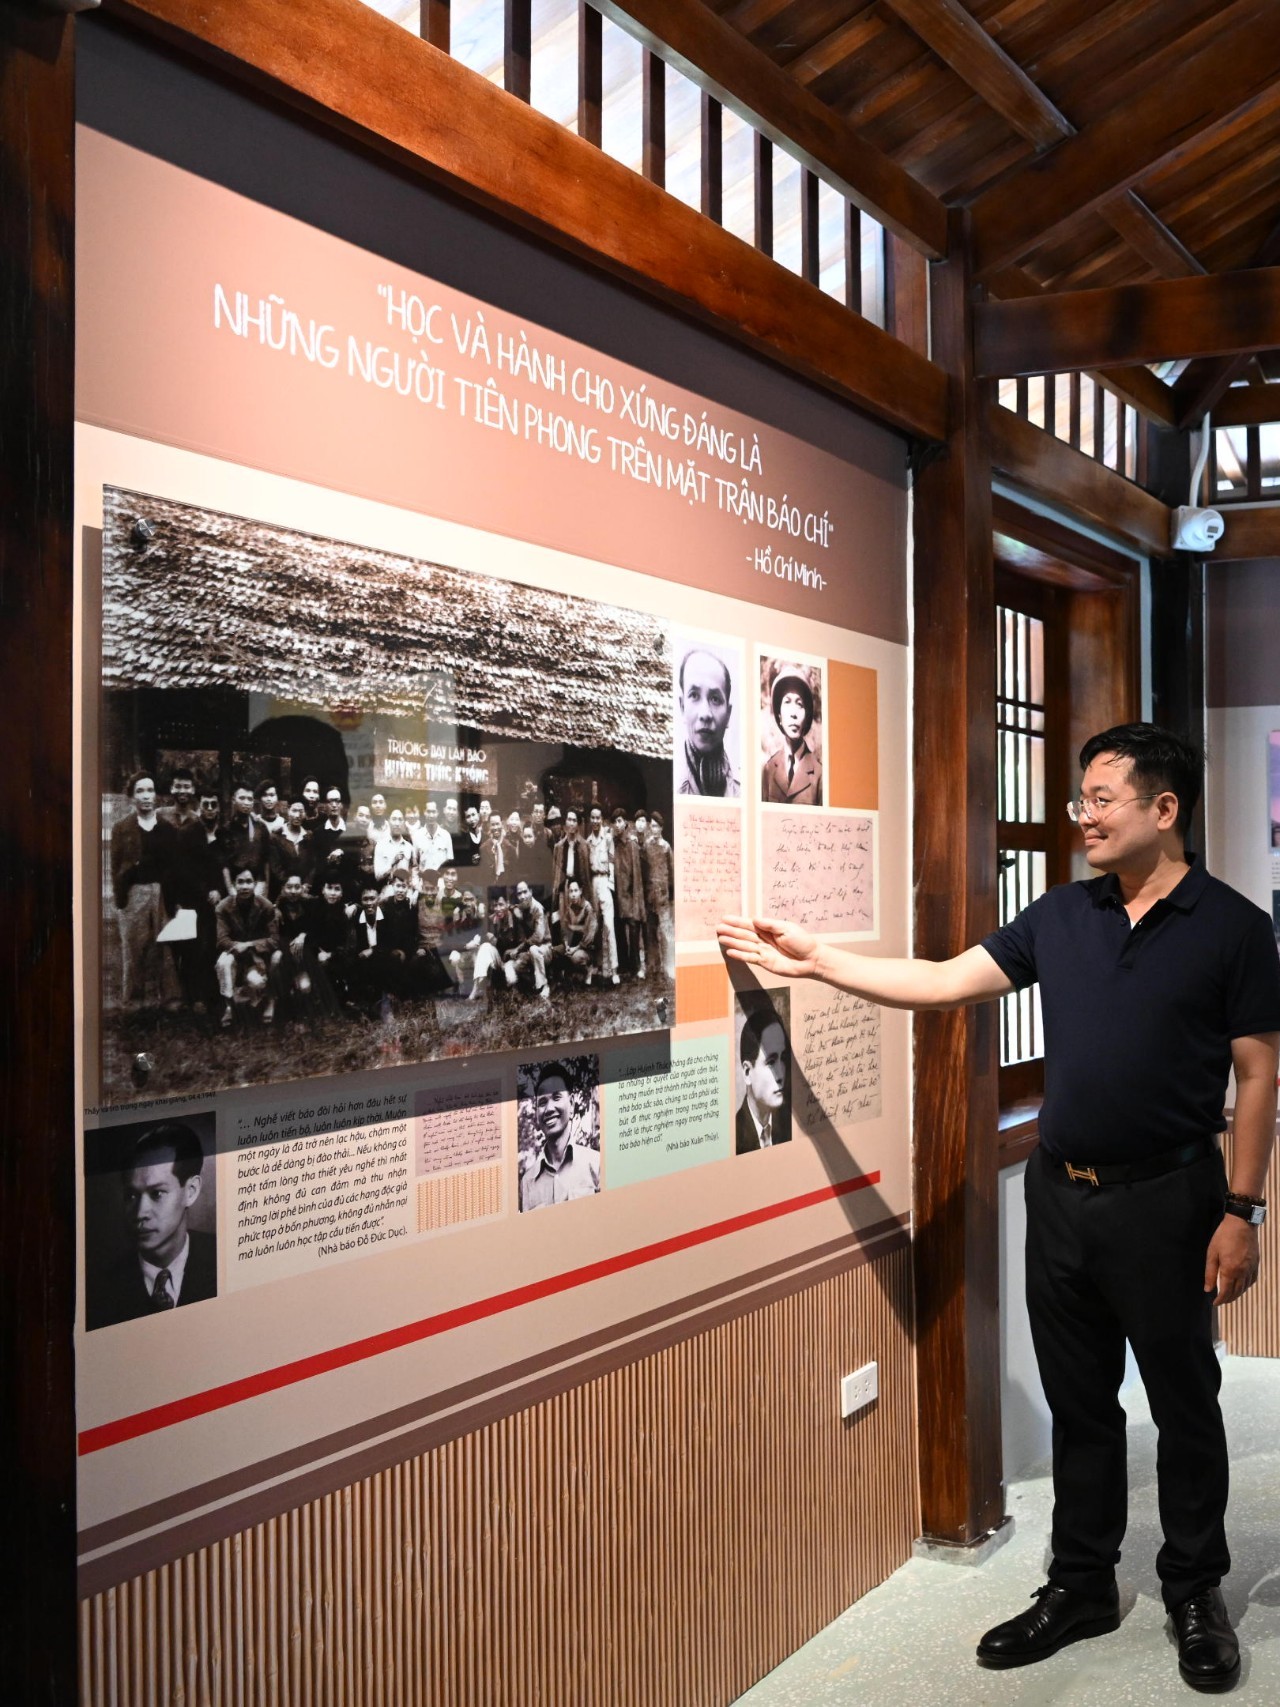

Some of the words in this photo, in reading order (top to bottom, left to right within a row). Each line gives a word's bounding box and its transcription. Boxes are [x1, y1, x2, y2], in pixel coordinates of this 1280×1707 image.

[213, 282, 340, 369] NHỮNG
[347, 334, 446, 410] NGƯỜI
[454, 376, 519, 437] TIÊN
[524, 403, 602, 464] PHONG
[607, 435, 662, 488] TRÊN
[666, 457, 711, 507] MẶT
[714, 477, 764, 526] TRẬN
[767, 493, 801, 538] BÁO
[450, 310, 491, 365] VÀ
[497, 328, 567, 397] HÀNH
[571, 367, 615, 415] CHO
[619, 384, 680, 441] XỨNG
[682, 411, 738, 465] ĐÁNG
[740, 432, 763, 476] LÀ
[774, 554, 794, 579] Chí
[237, 1134, 258, 1146] luôn
[259, 1130, 279, 1142] luôn
[313, 1121, 332, 1133] luôn
[333, 1118, 352, 1129] luôn
[254, 1112, 278, 1128] Nghề
[280, 1110, 296, 1122] viết
[298, 1108, 315, 1119] báo
[237, 1151, 256, 1163] một
[258, 1147, 280, 1159] ngày
[281, 1144, 290, 1154] là
[291, 1142, 303, 1152] đã
[305, 1138, 317, 1150] trở
[319, 1136, 335, 1147] nên
[237, 1166, 260, 1178] bước
[261, 1163, 270, 1174] là
[283, 1158, 306, 1170] dàng
[306, 1155, 315, 1166] bị
[316, 1152, 332, 1163] đào
[356, 1143, 372, 1155] Nếu
[373, 1140, 398, 1152] không
[398, 1136, 407, 1147] có
[237, 1183, 256, 1195] một
[259, 1177, 277, 1190] tấm
[280, 1175, 299, 1187] lòng
[301, 1171, 316, 1182] tha
[318, 1165, 337, 1178] thiết
[338, 1163, 353, 1177] yêu
[355, 1157, 376, 1172] nghề
[389, 1151, 408, 1164] nhất
[237, 1197, 258, 1213] định
[263, 1193, 291, 1207] không
[295, 1187, 307, 1199] đủ
[310, 1185, 327, 1196] can
[330, 1179, 349, 1192] đảm
[353, 1175, 367, 1187] mà
[370, 1172, 384, 1183] thu
[387, 1167, 407, 1179] nhận
[237, 1214, 268, 1228] những
[280, 1205, 297, 1220] phê
[297, 1201, 317, 1215] bình
[317, 1198, 333, 1210] của
[333, 1194, 344, 1206] đủ
[345, 1192, 360, 1203] các
[380, 1184, 395, 1197] độc
[237, 1230, 261, 1248] phức
[261, 1228, 277, 1240] tạp
[277, 1224, 284, 1235] ở
[284, 1219, 302, 1234] bốn
[337, 1208, 363, 1221] không
[363, 1202, 375, 1215] đủ
[237, 1248, 254, 1261] mà
[254, 1244, 275, 1257] luôn
[276, 1239, 296, 1251] luôn
[296, 1235, 313, 1248] học
[313, 1230, 328, 1243] tập
[345, 1221, 361, 1234] tiến
[339, 1239, 356, 1251] báo
[370, 1231, 387, 1243] Đức
